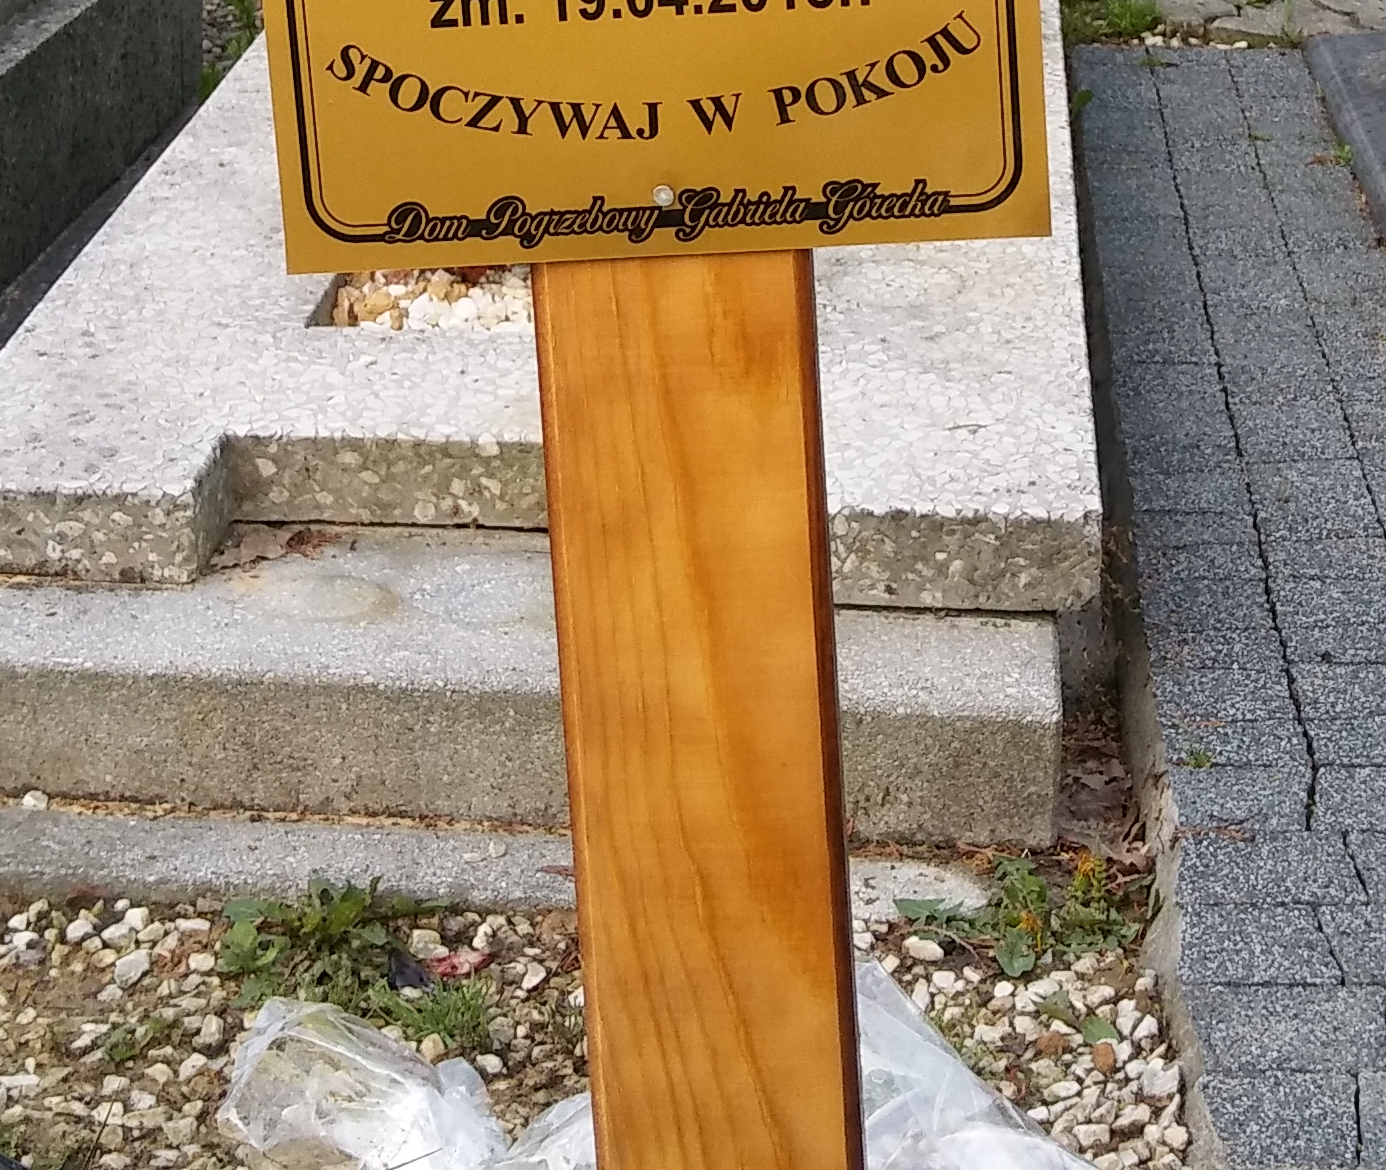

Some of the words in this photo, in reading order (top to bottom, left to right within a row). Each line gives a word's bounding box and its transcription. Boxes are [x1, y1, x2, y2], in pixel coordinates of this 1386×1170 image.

[324, 43, 664, 141] SPOCZYWAJ
[685, 92, 743, 136] W
[765, 8, 984, 128] POKOJU
[386, 202, 470, 244] Dom
[481, 196, 661, 248] Pogrzebowy
[675, 186, 811, 242] Gabriela
[819, 179, 949, 235] Górecka
